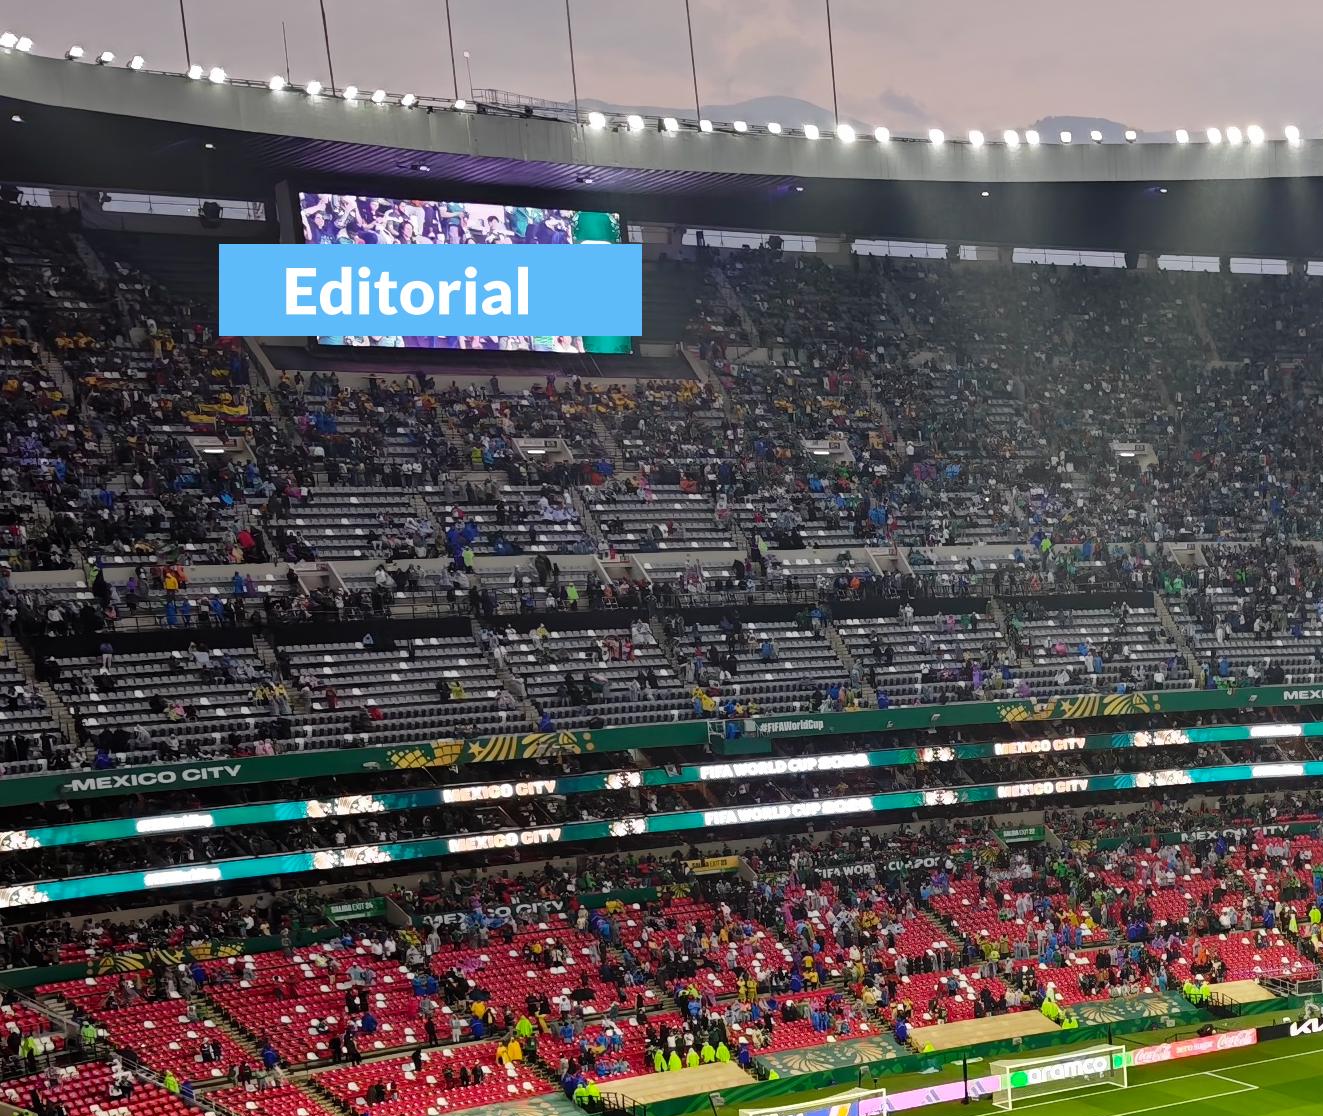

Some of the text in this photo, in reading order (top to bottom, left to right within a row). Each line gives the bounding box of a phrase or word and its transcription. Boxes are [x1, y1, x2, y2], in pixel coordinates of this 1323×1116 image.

[759, 718, 824, 733] #FIFAWorldCup
[72, 765, 242, 792] MEXICO CITY
[1028, 1057, 1108, 1085] aramco
